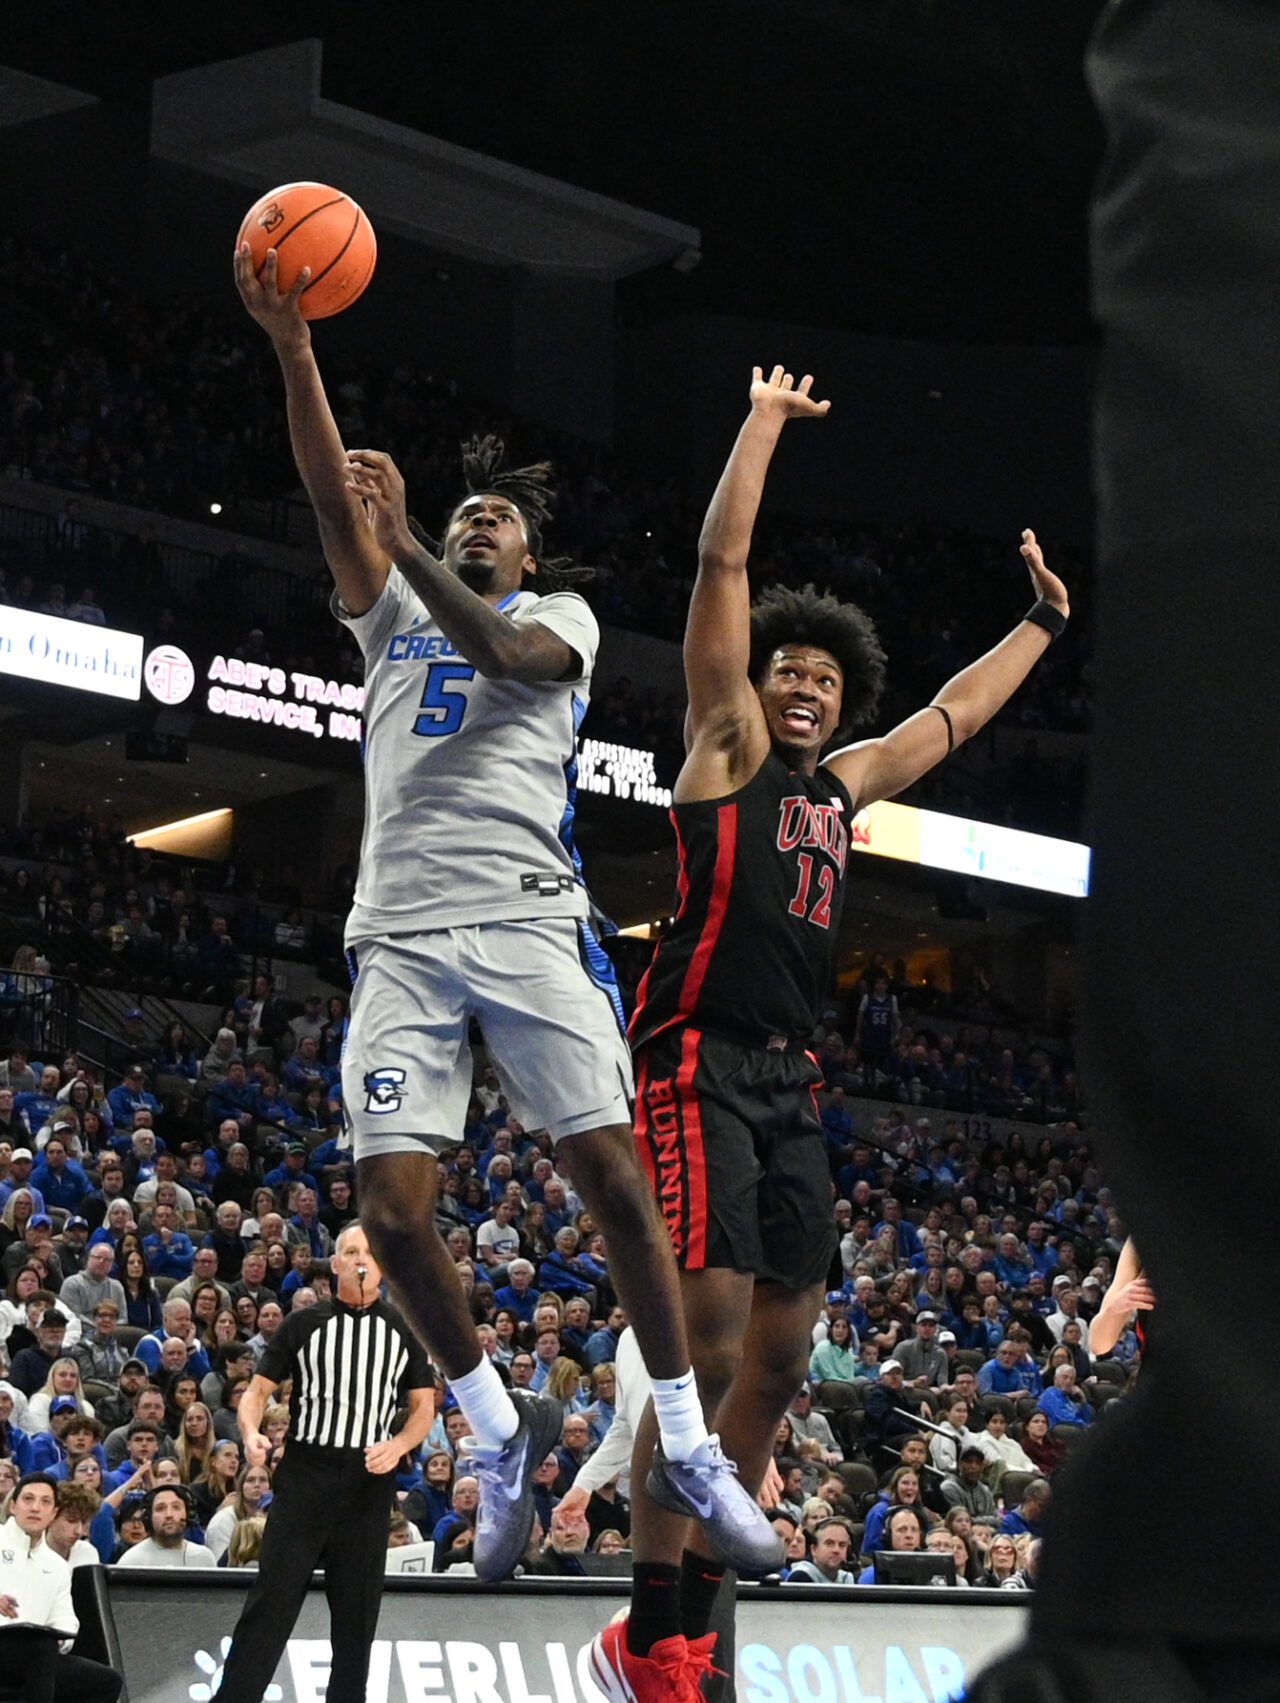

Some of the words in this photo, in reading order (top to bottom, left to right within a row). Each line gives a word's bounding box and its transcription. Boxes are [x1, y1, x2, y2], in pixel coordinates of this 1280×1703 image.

[27, 633, 138, 680] Omaha
[207, 655, 287, 695] ABE'S
[207, 687, 324, 738] SERVICE,
[411, 662, 477, 737] 5
[787, 851, 834, 930] 12
[962, 1118, 993, 1142] 123
